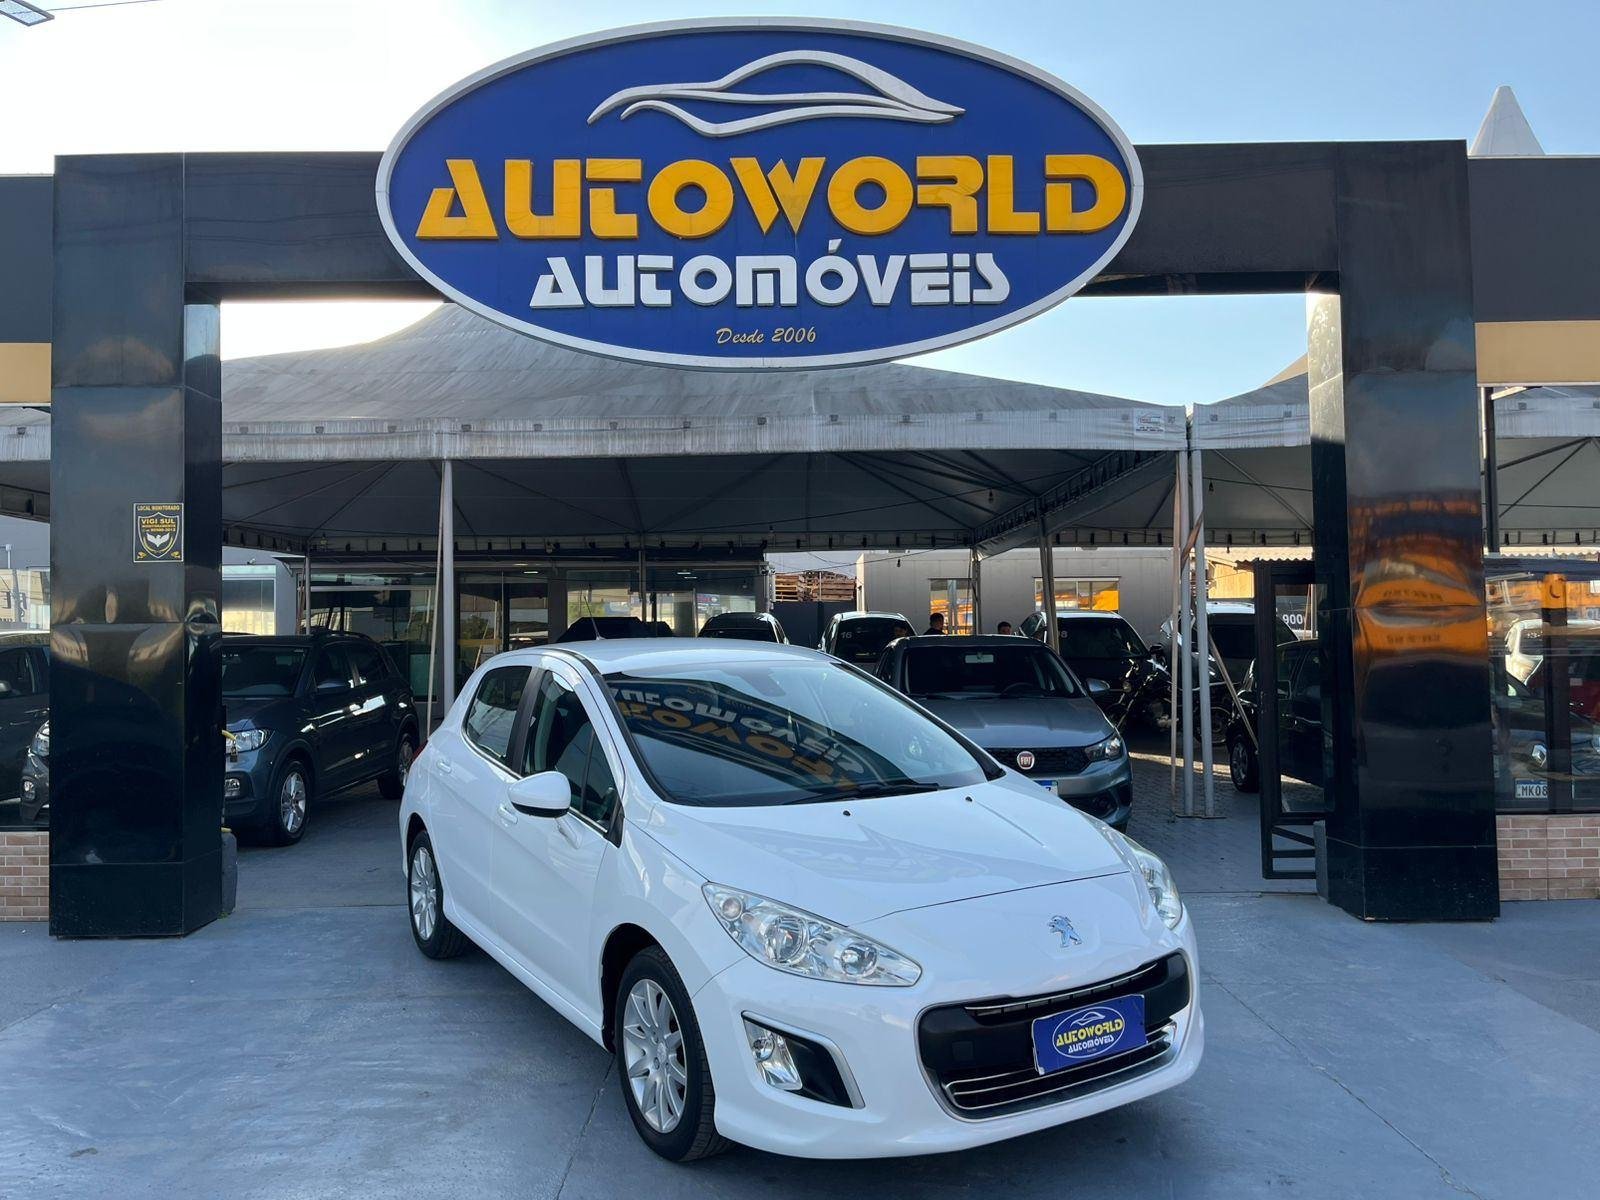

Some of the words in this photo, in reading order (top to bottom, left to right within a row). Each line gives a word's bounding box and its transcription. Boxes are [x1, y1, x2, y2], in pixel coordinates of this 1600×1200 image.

[415, 154, 1127, 240] AUTOWORLD
[529, 239, 1011, 308] AUTOMÓVEIS
[716, 328, 764, 344] Desde
[771, 326, 816, 343] 2006
[1056, 1018, 1124, 1047] AUTOWORLD
[1067, 1035, 1115, 1054] AUTOMÓVEIS
